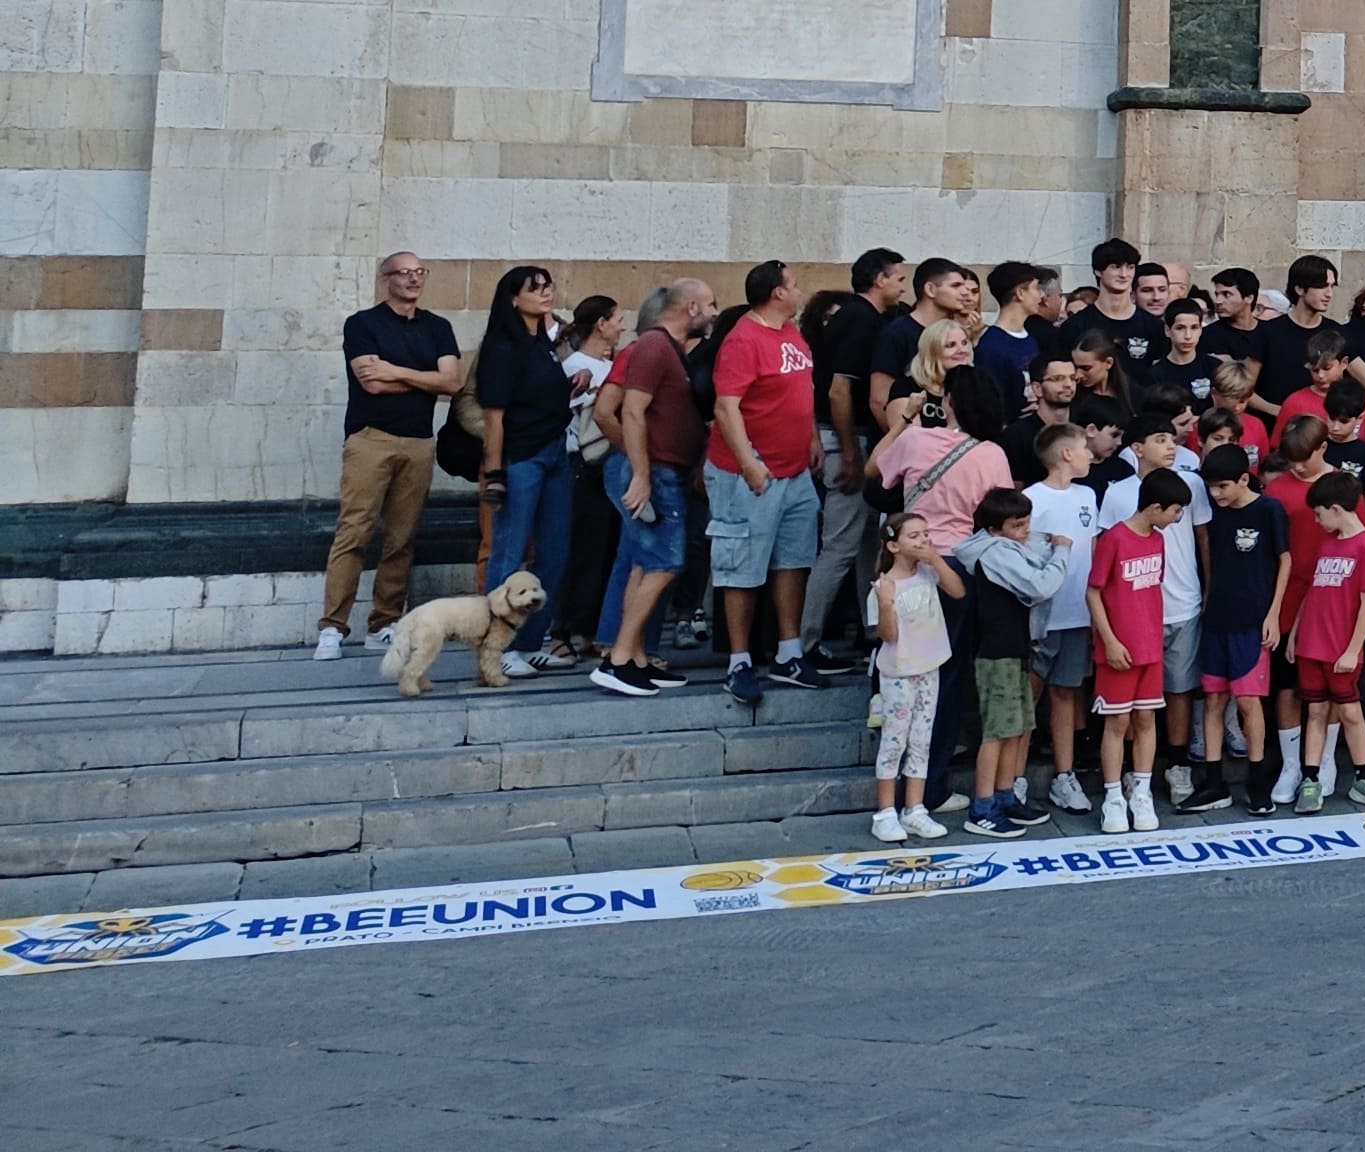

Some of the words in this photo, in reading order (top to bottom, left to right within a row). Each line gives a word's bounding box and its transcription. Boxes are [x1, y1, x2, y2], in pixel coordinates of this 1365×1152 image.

[1124, 555, 1162, 578] UNIO
[1317, 558, 1355, 576] NION
[1075, 834, 1188, 849] FOLLOW
[1196, 832, 1230, 840] US
[1011, 829, 1361, 876] #BEEUNION
[848, 865, 990, 889] UNION
[330, 892, 472, 910] FOLLOW
[480, 888, 519, 898] US
[236, 888, 657, 939] #BEEUNION
[27, 924, 209, 957] UNION
[304, 930, 394, 946] PRATO
[421, 923, 503, 935] CAMPI
